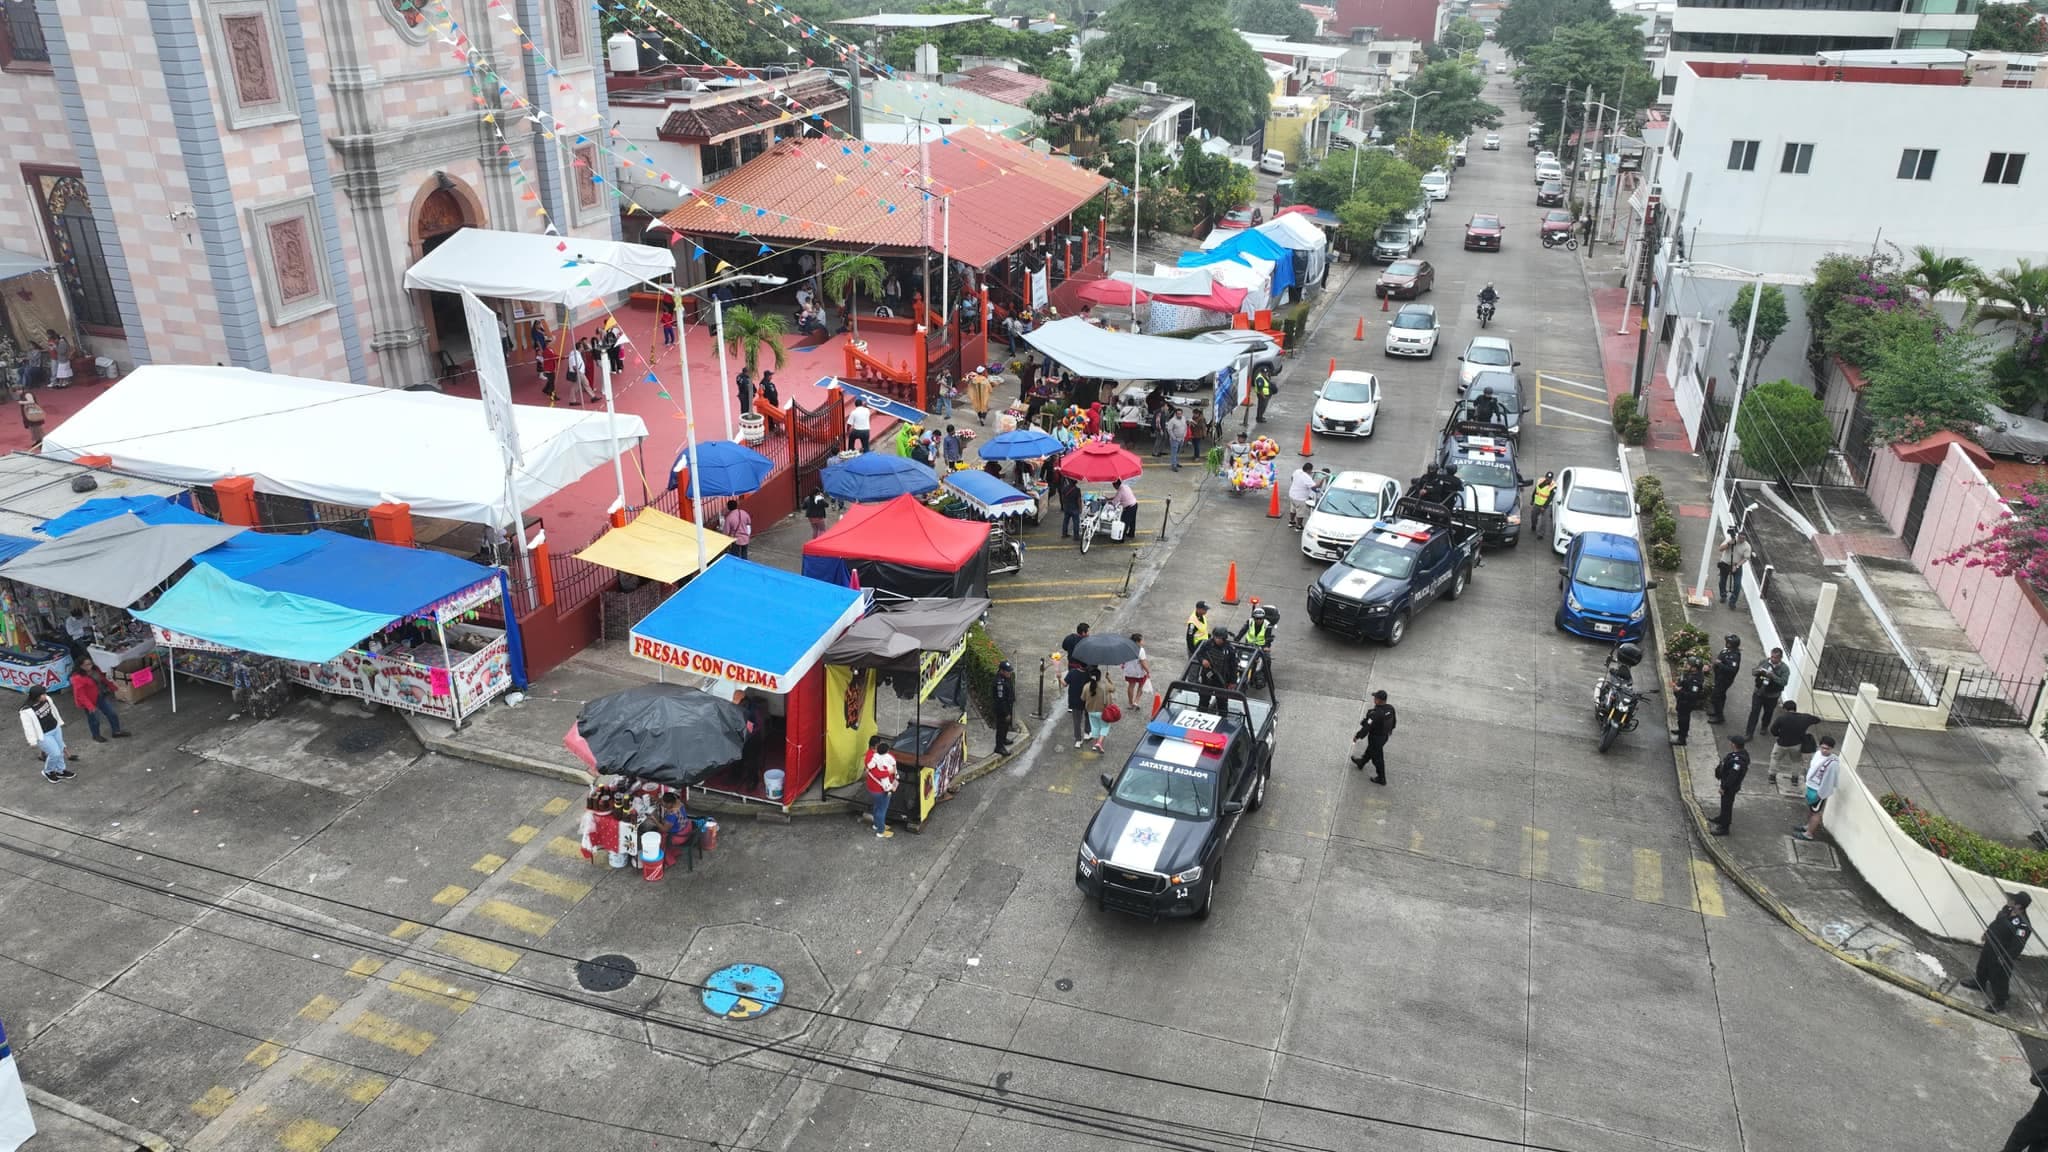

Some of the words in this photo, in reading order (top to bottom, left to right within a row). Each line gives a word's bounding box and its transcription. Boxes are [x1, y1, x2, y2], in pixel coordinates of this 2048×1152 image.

[0, 665, 61, 687] PESCA
[634, 635, 690, 669] FRESAS
[692, 653, 723, 677] CON
[726, 663, 778, 689] CREMA
